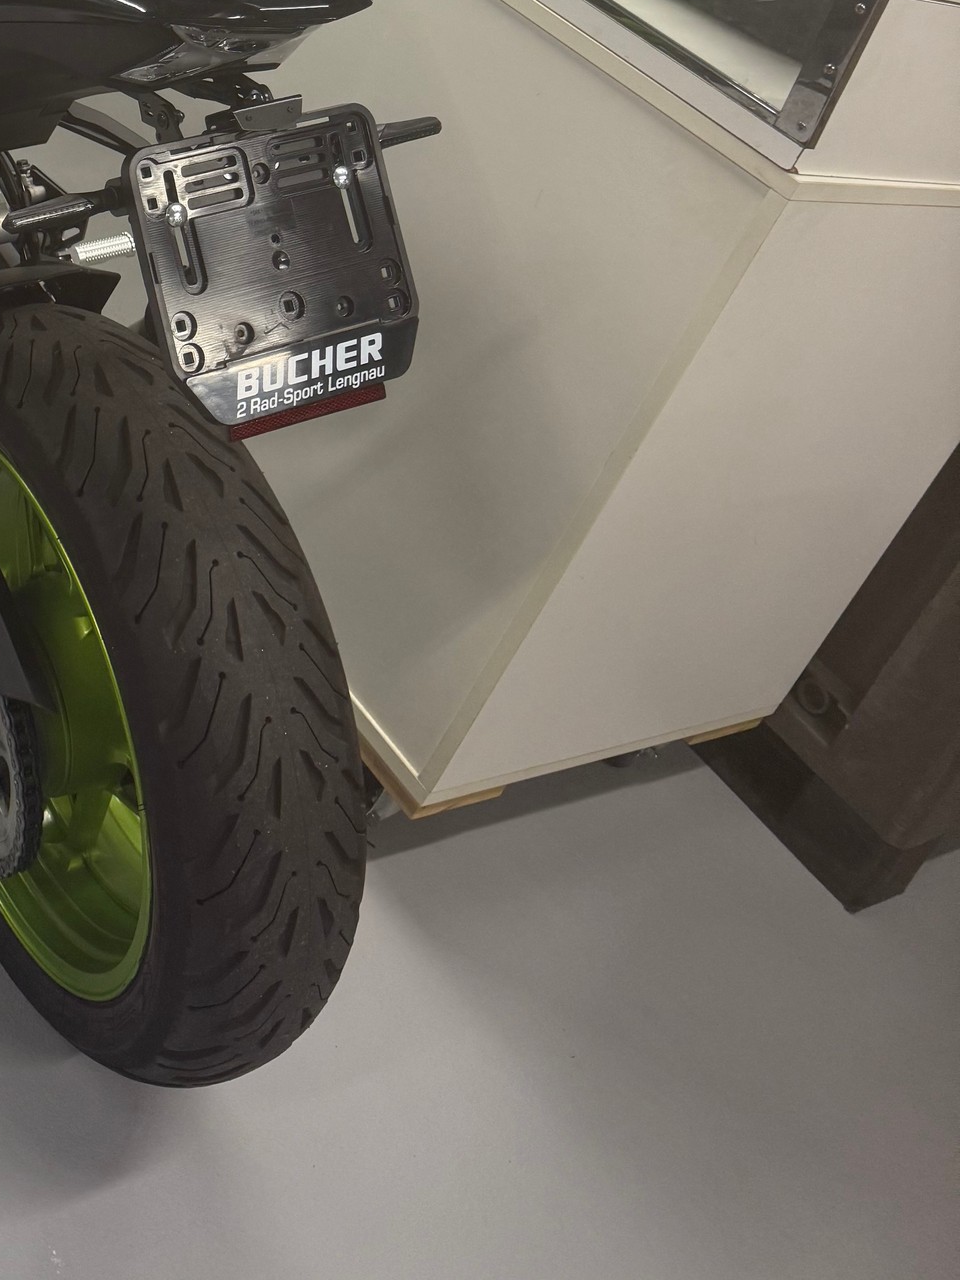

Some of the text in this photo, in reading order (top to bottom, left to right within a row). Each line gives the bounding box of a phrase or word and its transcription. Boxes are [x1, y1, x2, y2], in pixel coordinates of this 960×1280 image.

[236, 332, 383, 401] BUCHER
[236, 365, 385, 418] 2 Rad-Sport Lengnau
